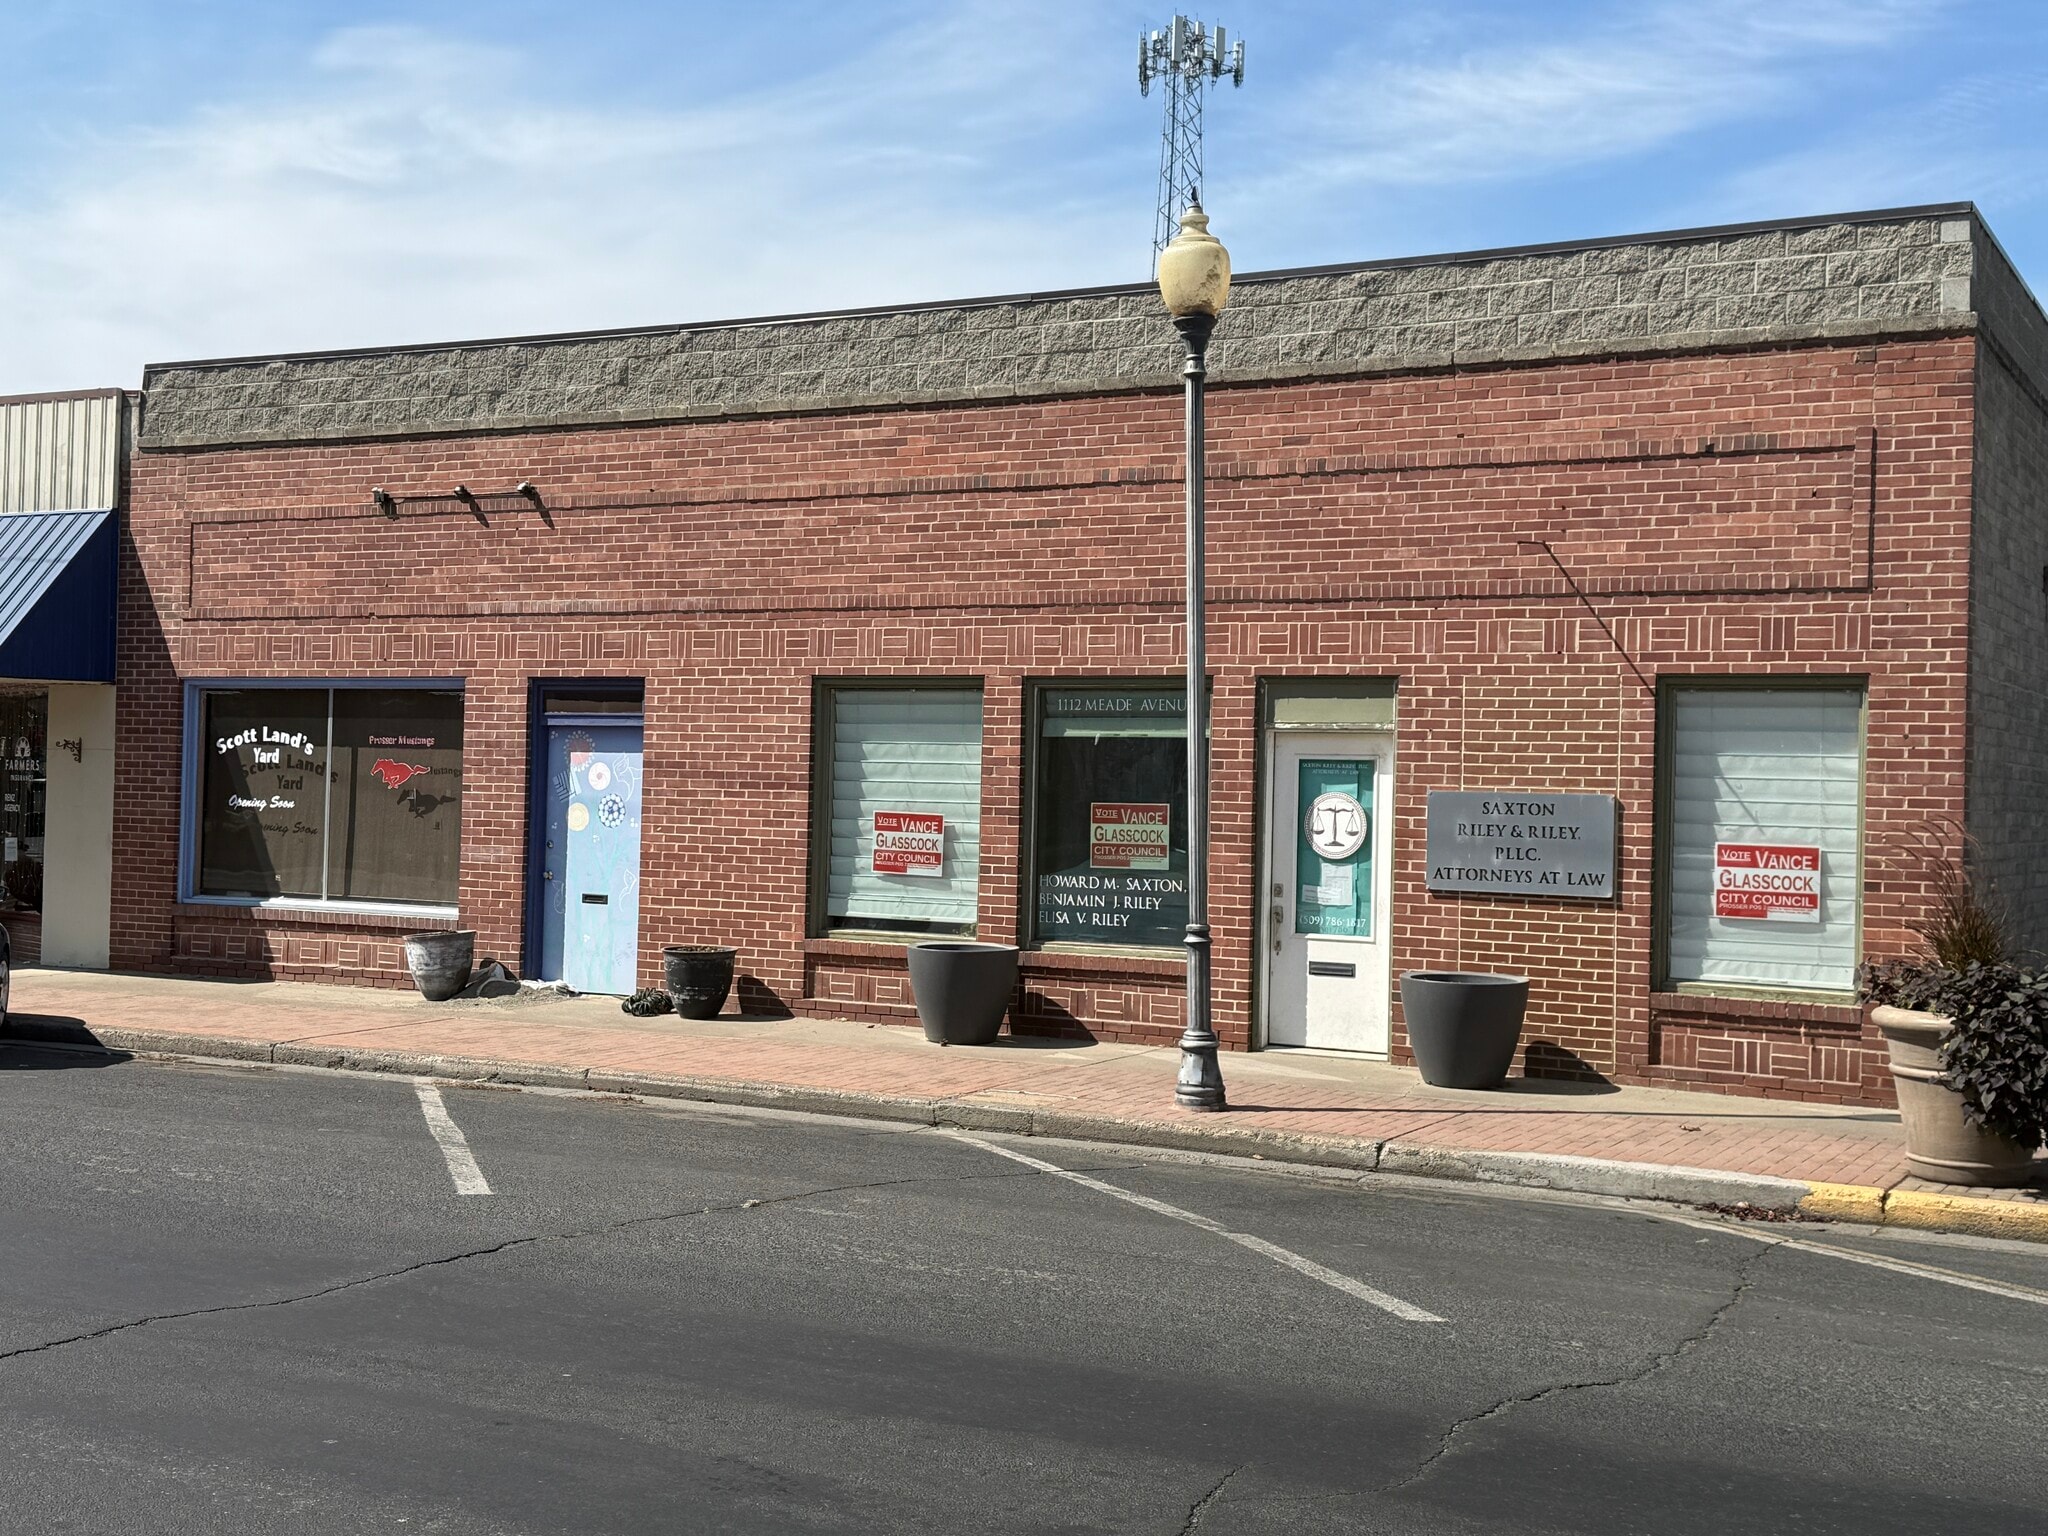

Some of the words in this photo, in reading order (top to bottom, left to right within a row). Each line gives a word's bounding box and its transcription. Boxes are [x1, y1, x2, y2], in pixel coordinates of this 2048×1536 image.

[1058, 699, 1081, 711] 1112
[1085, 699, 1132, 712] MEADE
[1140, 699, 1188, 712] AVENU
[216, 728, 257, 754] Scott
[262, 726, 314, 755] Land's
[253, 747, 280, 763] Yard
[5, 759, 40, 771] FARMERS
[228, 794, 267, 812] Opening
[269, 795, 296, 808] Soon
[1482, 801, 1555, 816] SAXTON
[1095, 808, 1119, 817] VOTE
[1121, 808, 1163, 825] VANCE
[877, 816, 898, 825] VOTE
[900, 817, 939, 834] VANCE
[1458, 823, 1507, 837] RILEY
[1510, 824, 1524, 838] &
[876, 832, 939, 851] GLASSCOCK
[1094, 825, 1164, 844] GLASSCOCK
[875, 852, 896, 861] CITY
[897, 854, 939, 864] COUNCIL
[1094, 846, 1117, 855] CITY
[1119, 846, 1165, 857] COUNCIL
[1495, 846, 1541, 861] PLLC.
[1721, 849, 1751, 861] VOTE
[1755, 850, 1813, 870] VANCE
[1040, 874, 1099, 890] HOWARD
[1103, 877, 1119, 890] M.
[1126, 877, 1187, 893] SAXTON,
[1433, 867, 1533, 884] ATTORNEYS
[1539, 872, 1560, 885] AT
[1567, 872, 1606, 886] LAW
[1720, 869, 1814, 892] GLASSCOCK
[1040, 892, 1105, 908] BENJAMIN
[1124, 896, 1162, 910] RILEY
[1719, 893, 1749, 904] CITY
[1752, 894, 1814, 907] COUNCIL
[1039, 911, 1070, 925] ELISA
[1077, 912, 1087, 924] V.
[1092, 912, 1130, 926] RILEY
[1299, 915, 1324, 926] (509)
